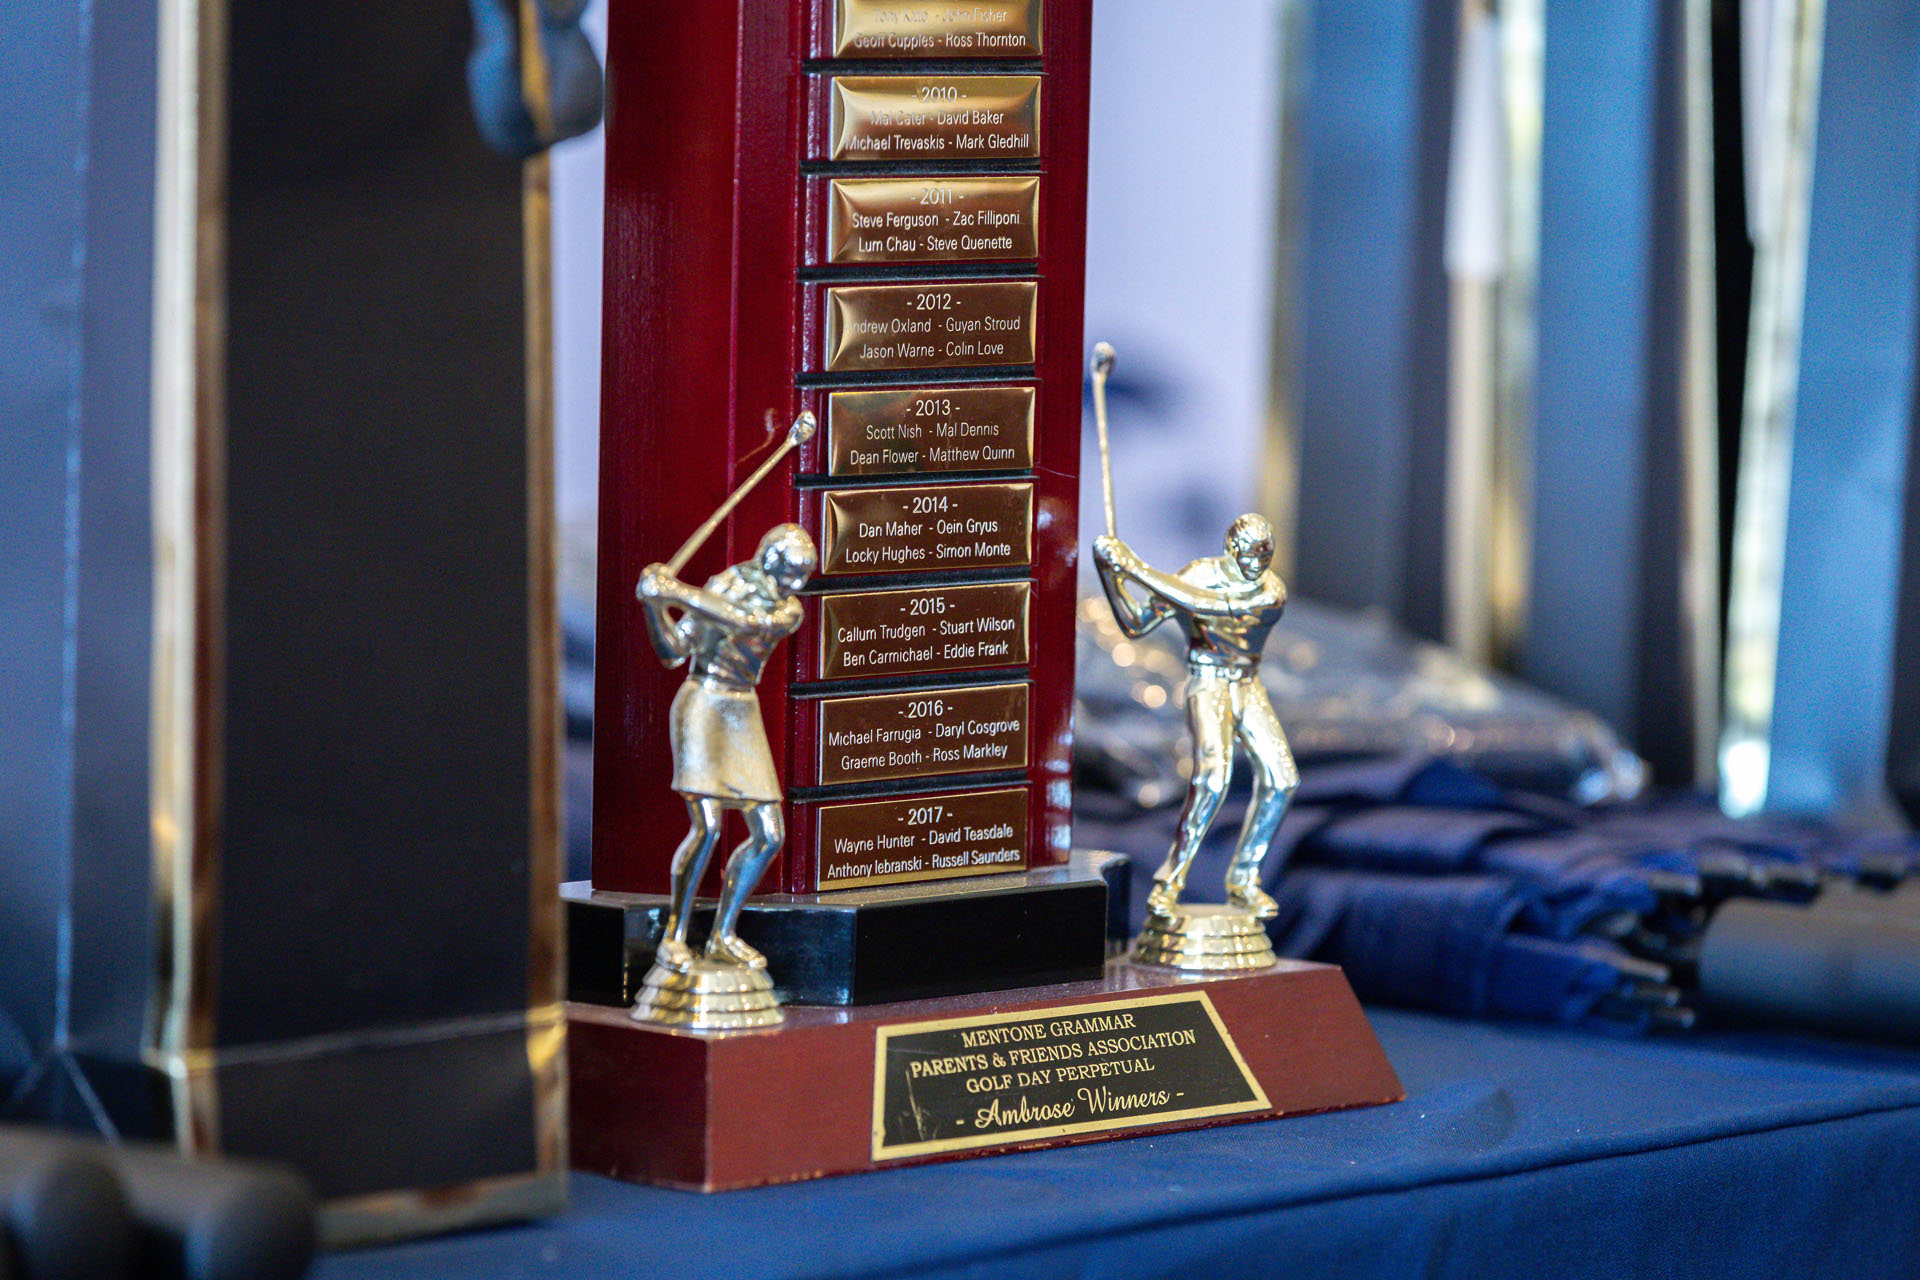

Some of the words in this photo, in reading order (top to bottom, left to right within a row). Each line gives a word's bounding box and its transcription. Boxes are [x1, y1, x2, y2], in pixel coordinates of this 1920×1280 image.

[973, 8, 1008, 23] Fisher
[854, 32, 885, 49] Geoff
[888, 32, 935, 51] Cupples
[945, 33, 973, 48] Ross
[975, 32, 1026, 47] Thornton
[921, 86, 958, 104] 2010
[871, 110, 892, 126] Mal
[895, 110, 926, 126] Cater
[937, 110, 969, 125] David
[972, 110, 1004, 125] Baker
[845, 135, 891, 150] Michael
[893, 134, 945, 150] Trevaskis
[956, 134, 985, 149] Mark
[987, 133, 1029, 148] Gledhill
[920, 188, 953, 205] 2011
[852, 212, 883, 228] Steve
[886, 212, 939, 231] Ferguson
[953, 211, 974, 226] Zac
[977, 210, 1020, 227] Filliponi
[858, 238, 883, 252] Lum
[886, 237, 916, 252] Chau
[927, 236, 958, 251] Steve
[961, 235, 1013, 250] Quenette
[916, 293, 952, 311] 2012
[891, 318, 931, 333] Oxland
[945, 317, 981, 334] Guyan
[984, 316, 1021, 331] Stroud
[860, 344, 894, 360] Jason
[897, 343, 935, 357] Warne
[946, 341, 975, 356] Colin
[977, 341, 1004, 355] Love
[915, 399, 951, 417] 2013
[866, 425, 895, 440] Scott
[898, 423, 922, 439] Nish
[936, 423, 957, 437] Mal
[960, 422, 999, 437] Dennis
[850, 450, 879, 465] Dean
[882, 449, 919, 464] Flower
[929, 447, 980, 462] Matthew
[982, 446, 1015, 461] Quinn
[912, 496, 948, 514] 2014
[859, 523, 883, 538] Dan
[886, 521, 923, 537] Maher
[936, 520, 963, 535] Oein
[966, 519, 998, 536] Gryus
[845, 548, 879, 565] Locky
[882, 546, 926, 564] Hughes
[936, 544, 971, 559] Simon
[974, 542, 1011, 557] Monte
[910, 598, 946, 616] 2015
[837, 627, 877, 643] Callum
[880, 624, 926, 642] Trudgen
[939, 619, 974, 636] Stuart
[976, 617, 1015, 633] Wilson
[843, 651, 866, 667] Ben
[869, 646, 933, 665] Carmichael
[943, 643, 975, 659] Eddie
[978, 641, 1009, 657] Frank
[907, 700, 944, 719] 2016
[828, 730, 873, 747] Michael
[876, 727, 922, 744] Farrugia
[935, 722, 965, 739] Daryl
[967, 718, 1021, 736] Cosgrove
[841, 753, 886, 771] Graeme
[889, 750, 922, 767] Booth
[933, 747, 960, 762] Ross
[963, 743, 1008, 760] Markley
[907, 806, 944, 826] 2017
[834, 838, 874, 855] Wayne
[877, 834, 915, 851] Hunter
[929, 828, 961, 845] David
[963, 824, 1013, 842] Teasdale
[827, 863, 873, 879] Anthony
[932, 852, 969, 869] Russell
[971, 848, 1021, 865] Saunders
[961, 1024, 1047, 1048] MENTONE
[1051, 1013, 1137, 1038] GRAMMAR
[910, 1054, 989, 1078] PARENTS
[992, 1055, 1007, 1068] &
[1010, 1044, 1083, 1067] FRIENDS
[1087, 1029, 1196, 1056] ASSOCIATION
[965, 1074, 1013, 1094] GOLF
[1018, 1069, 1051, 1087] DAY
[1055, 1058, 1155, 1083] PERPETUAL
[974, 1095, 1074, 1129] Ambrose
[1077, 1086, 1171, 1115] Winners
